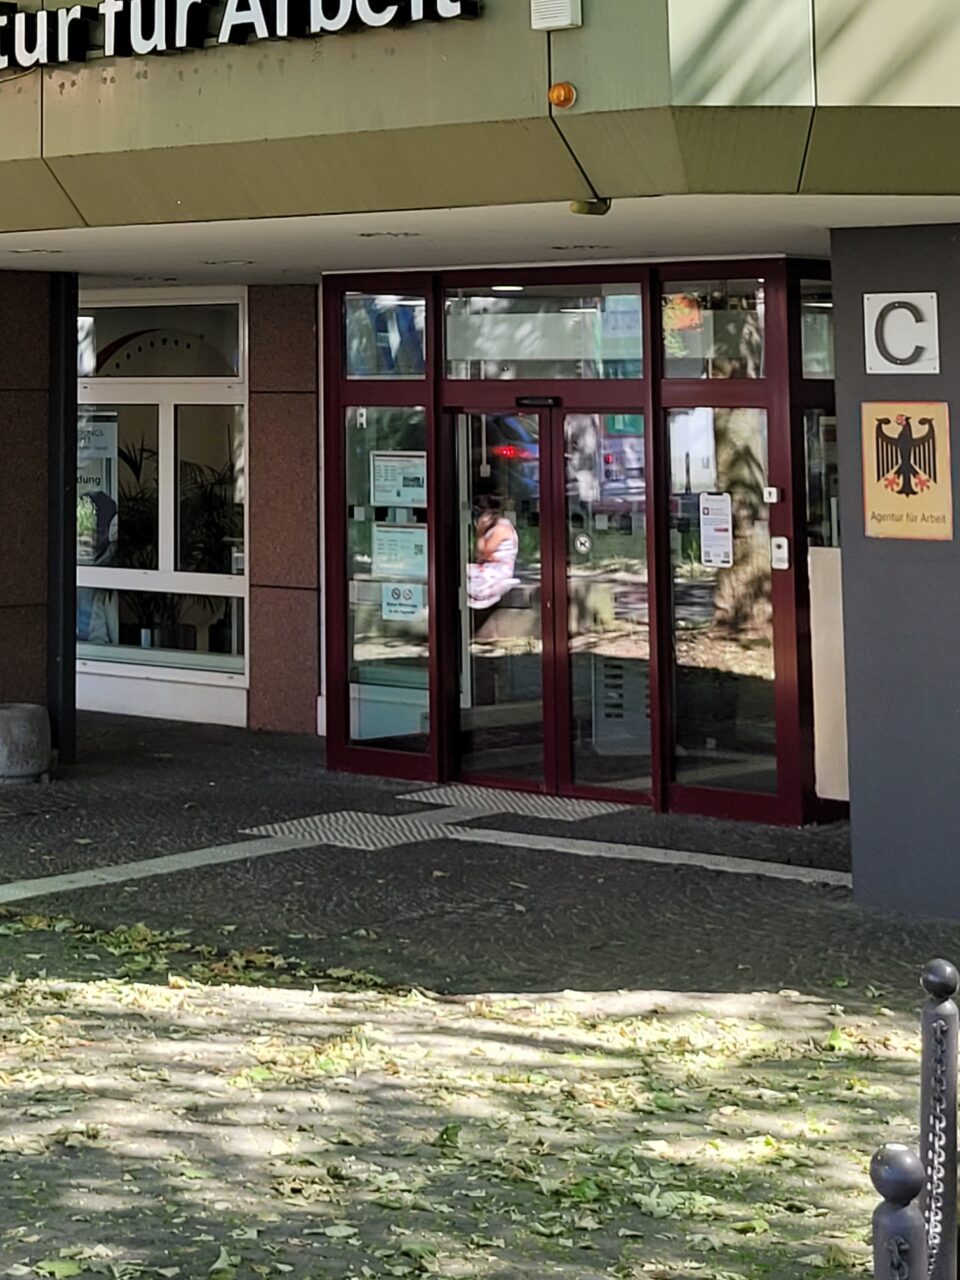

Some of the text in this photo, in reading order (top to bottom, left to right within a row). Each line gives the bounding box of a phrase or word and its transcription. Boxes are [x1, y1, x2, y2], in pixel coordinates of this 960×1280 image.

[874, 301, 925, 365] C
[871, 511, 946, 524] Agentur für Arbeit
